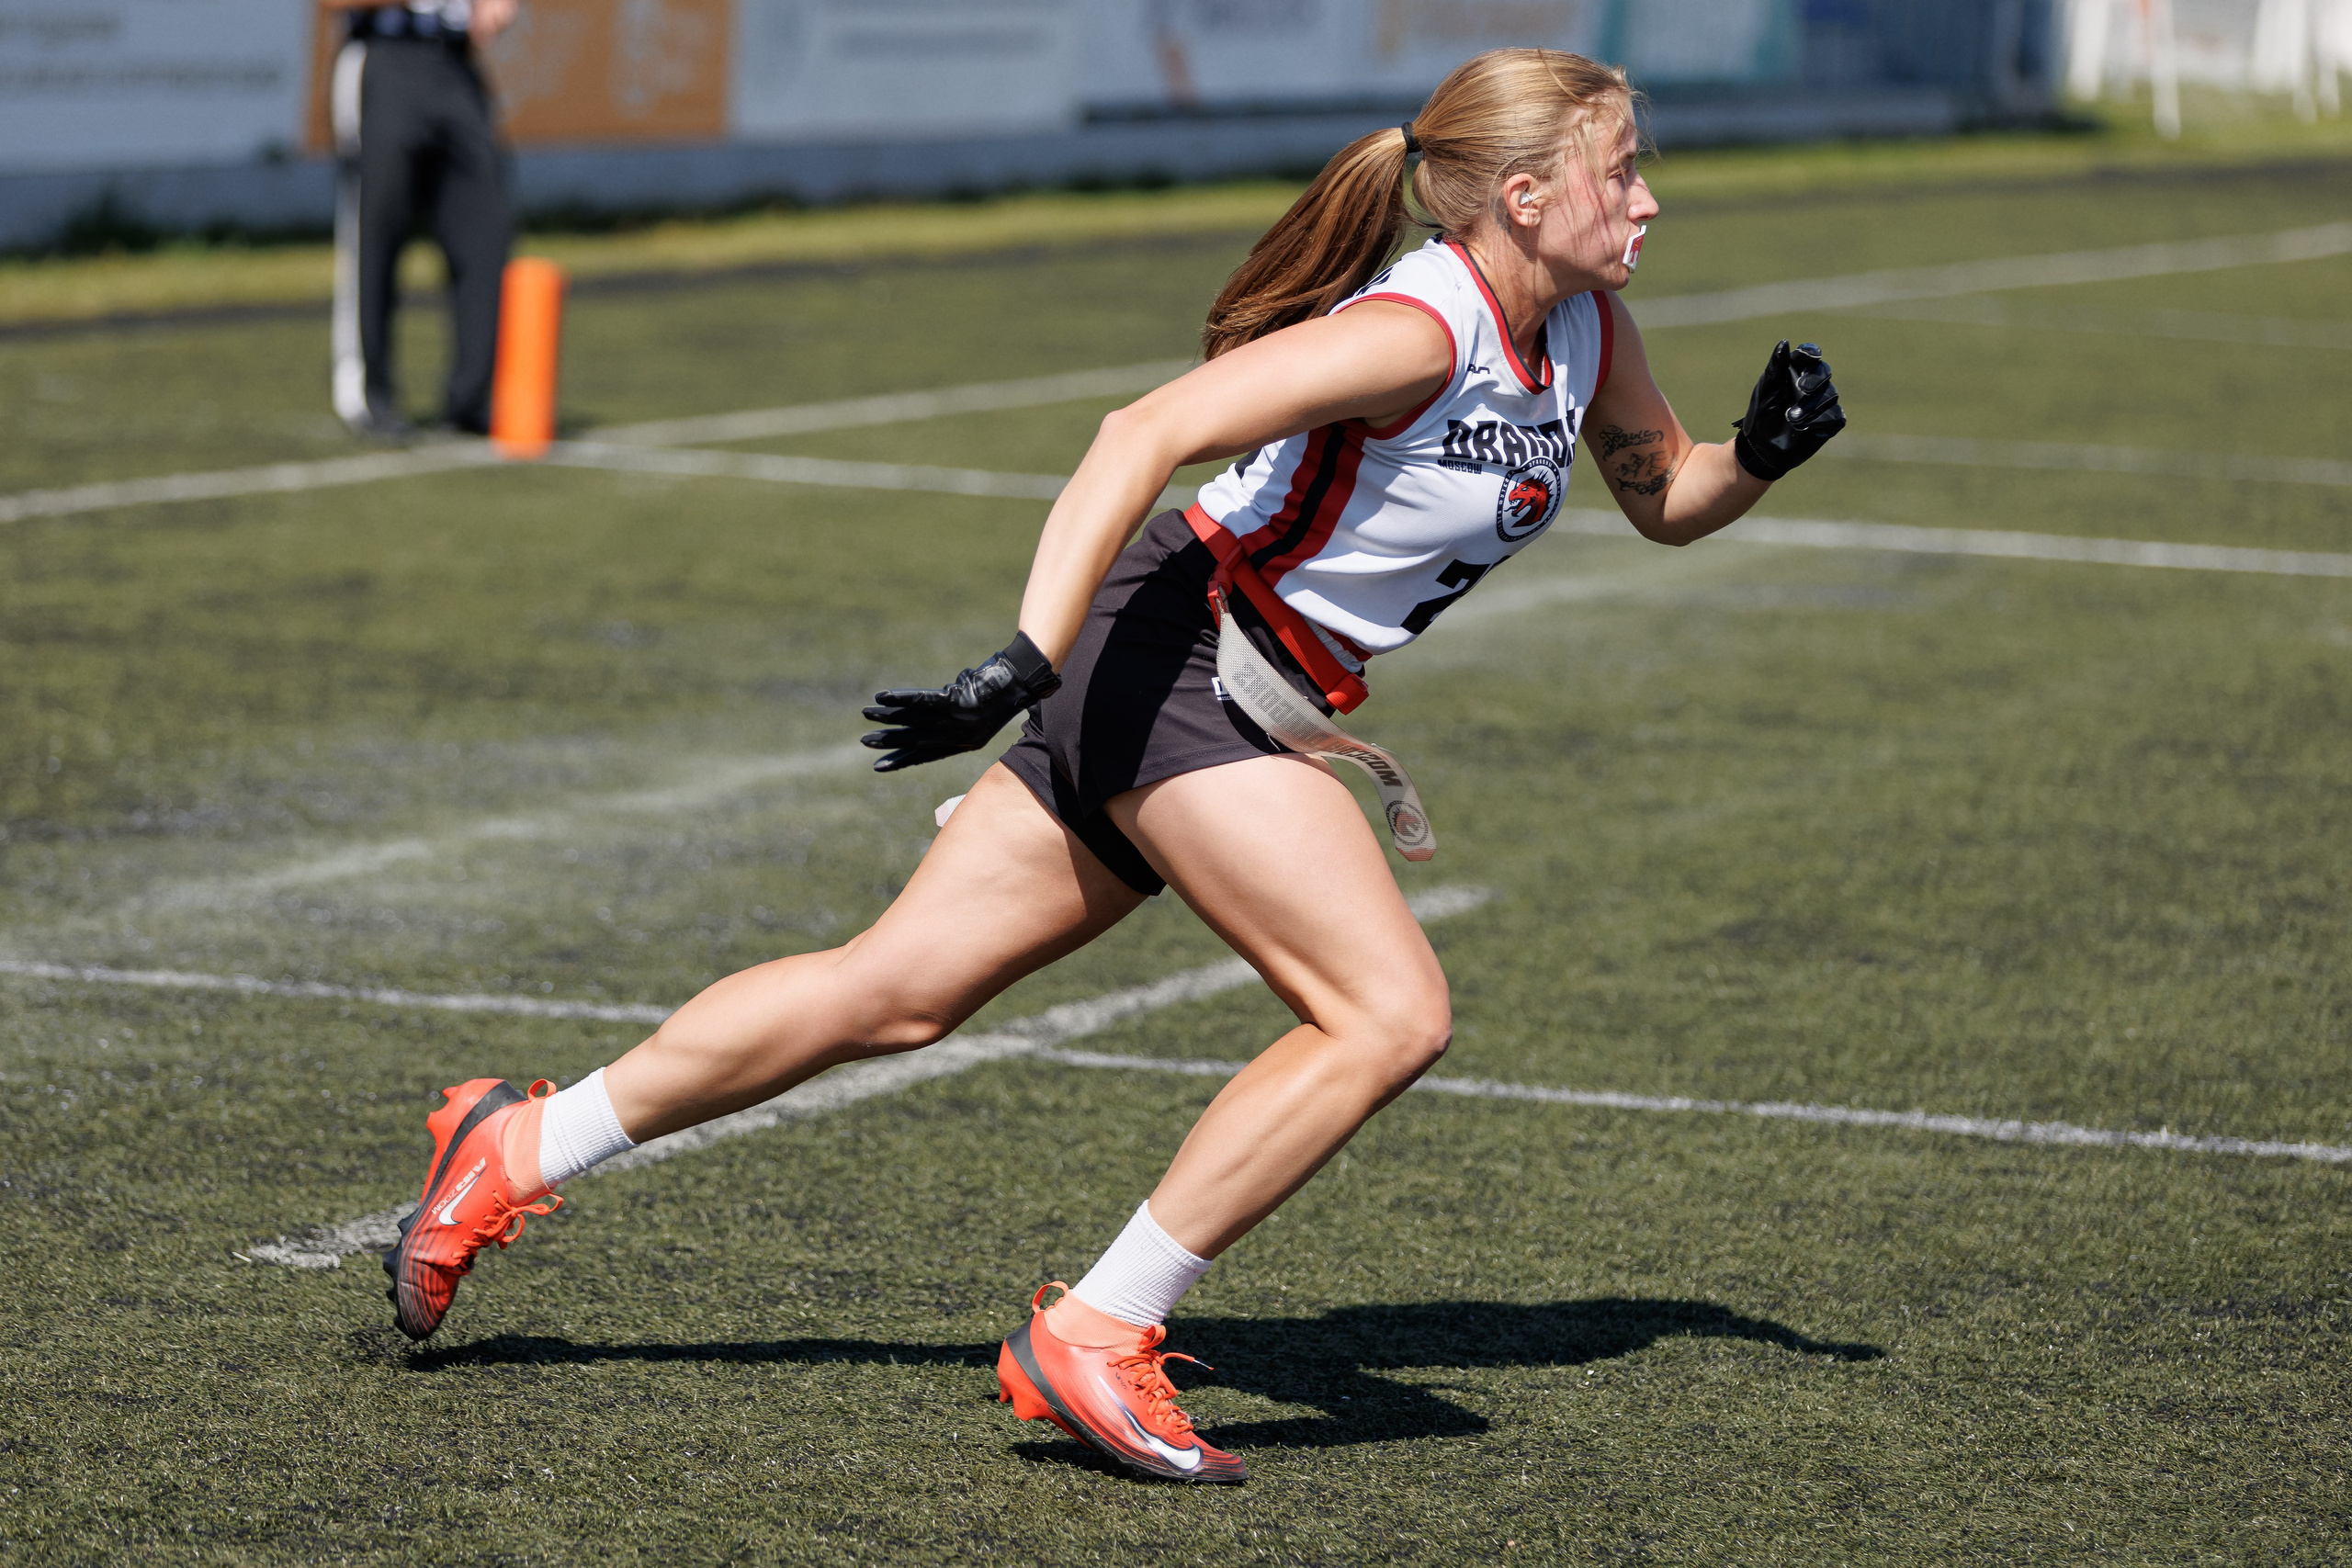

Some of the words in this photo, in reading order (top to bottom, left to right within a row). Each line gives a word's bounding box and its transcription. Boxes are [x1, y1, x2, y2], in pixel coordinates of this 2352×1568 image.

[1442, 409, 1576, 468] DRAGO
[1437, 459, 1483, 475] MOSCOW
[1400, 555, 1511, 635] 2
[455, 1156, 486, 1192] AIR
[431, 1189, 458, 1215] ZOOM
